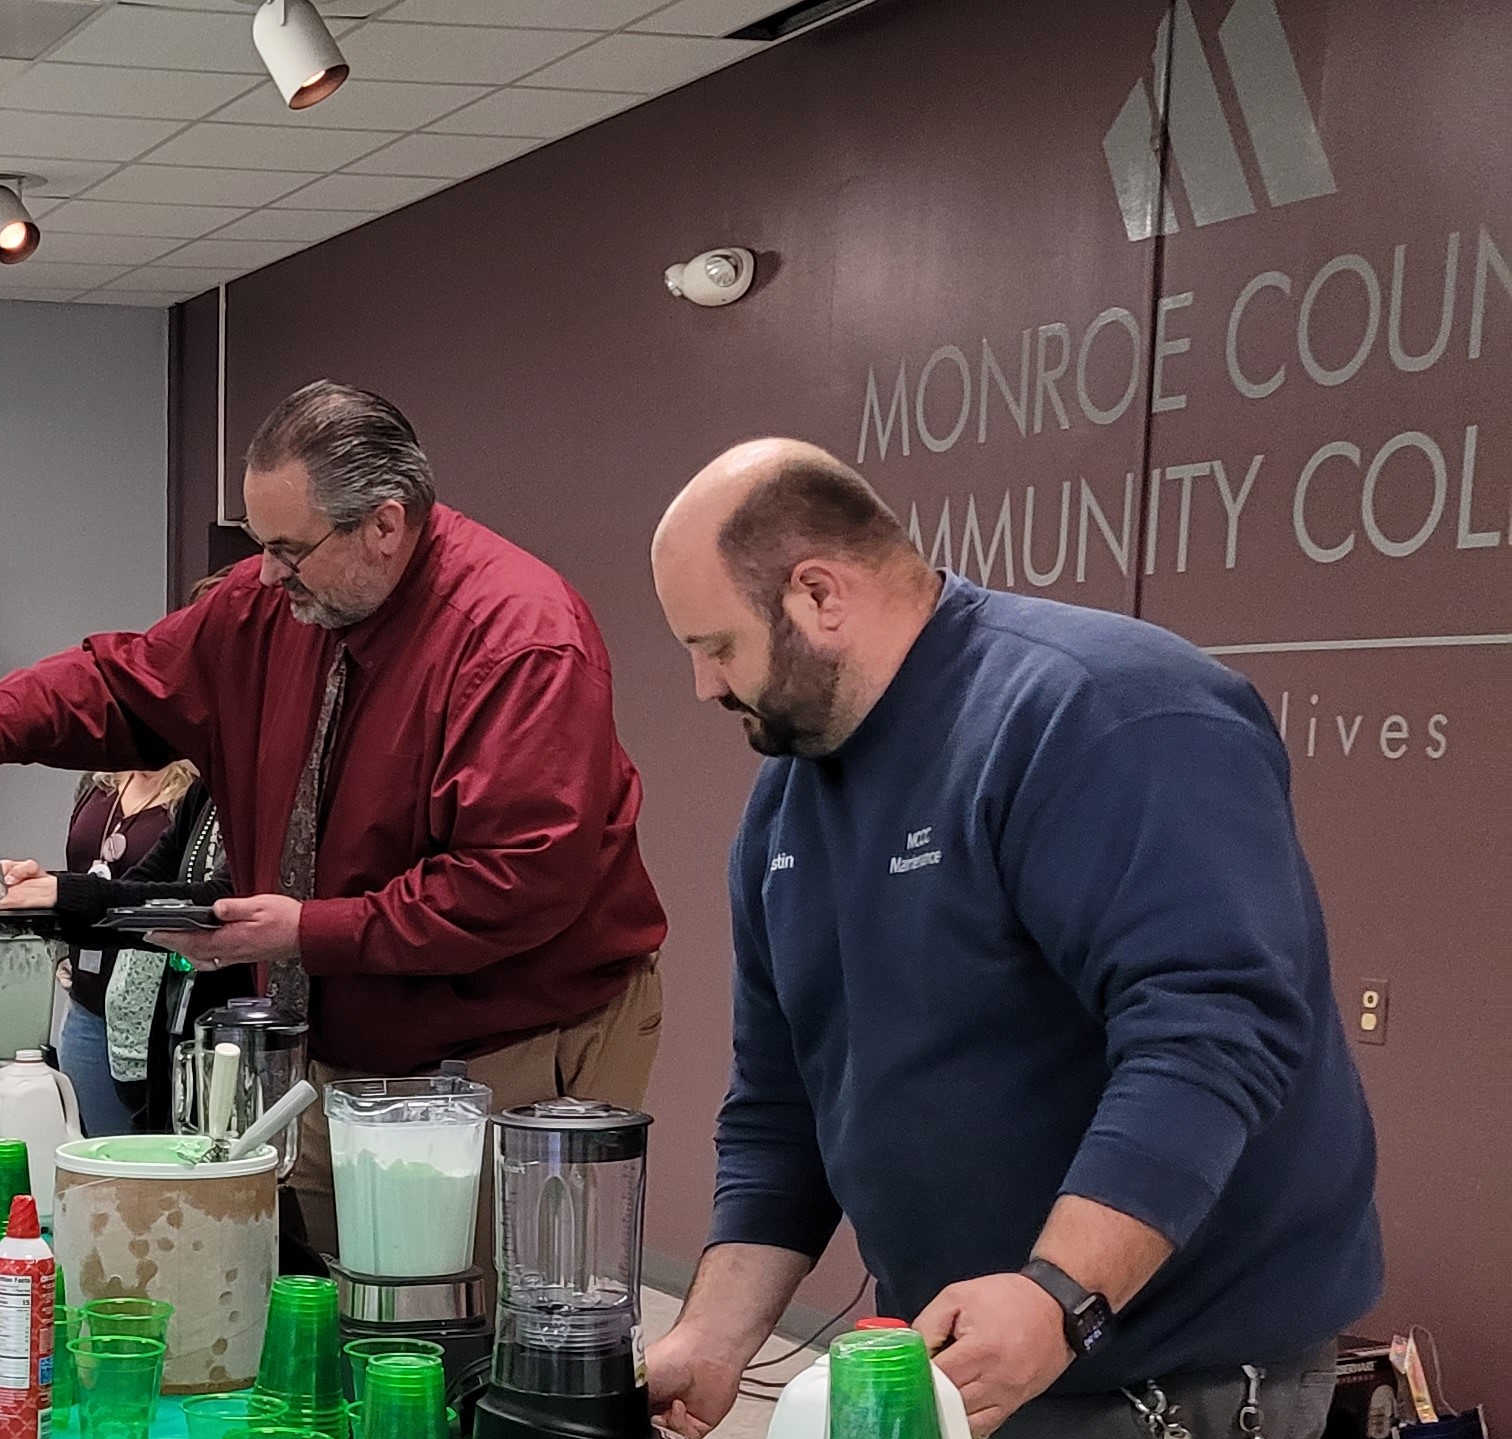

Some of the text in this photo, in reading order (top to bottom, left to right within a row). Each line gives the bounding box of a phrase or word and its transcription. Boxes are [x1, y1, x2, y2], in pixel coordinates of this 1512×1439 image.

[857, 291, 1194, 464] MONROE
[909, 425, 1512, 589] MMUNITY COL
[1280, 691, 1449, 759] lives
[770, 851, 795, 871] stin
